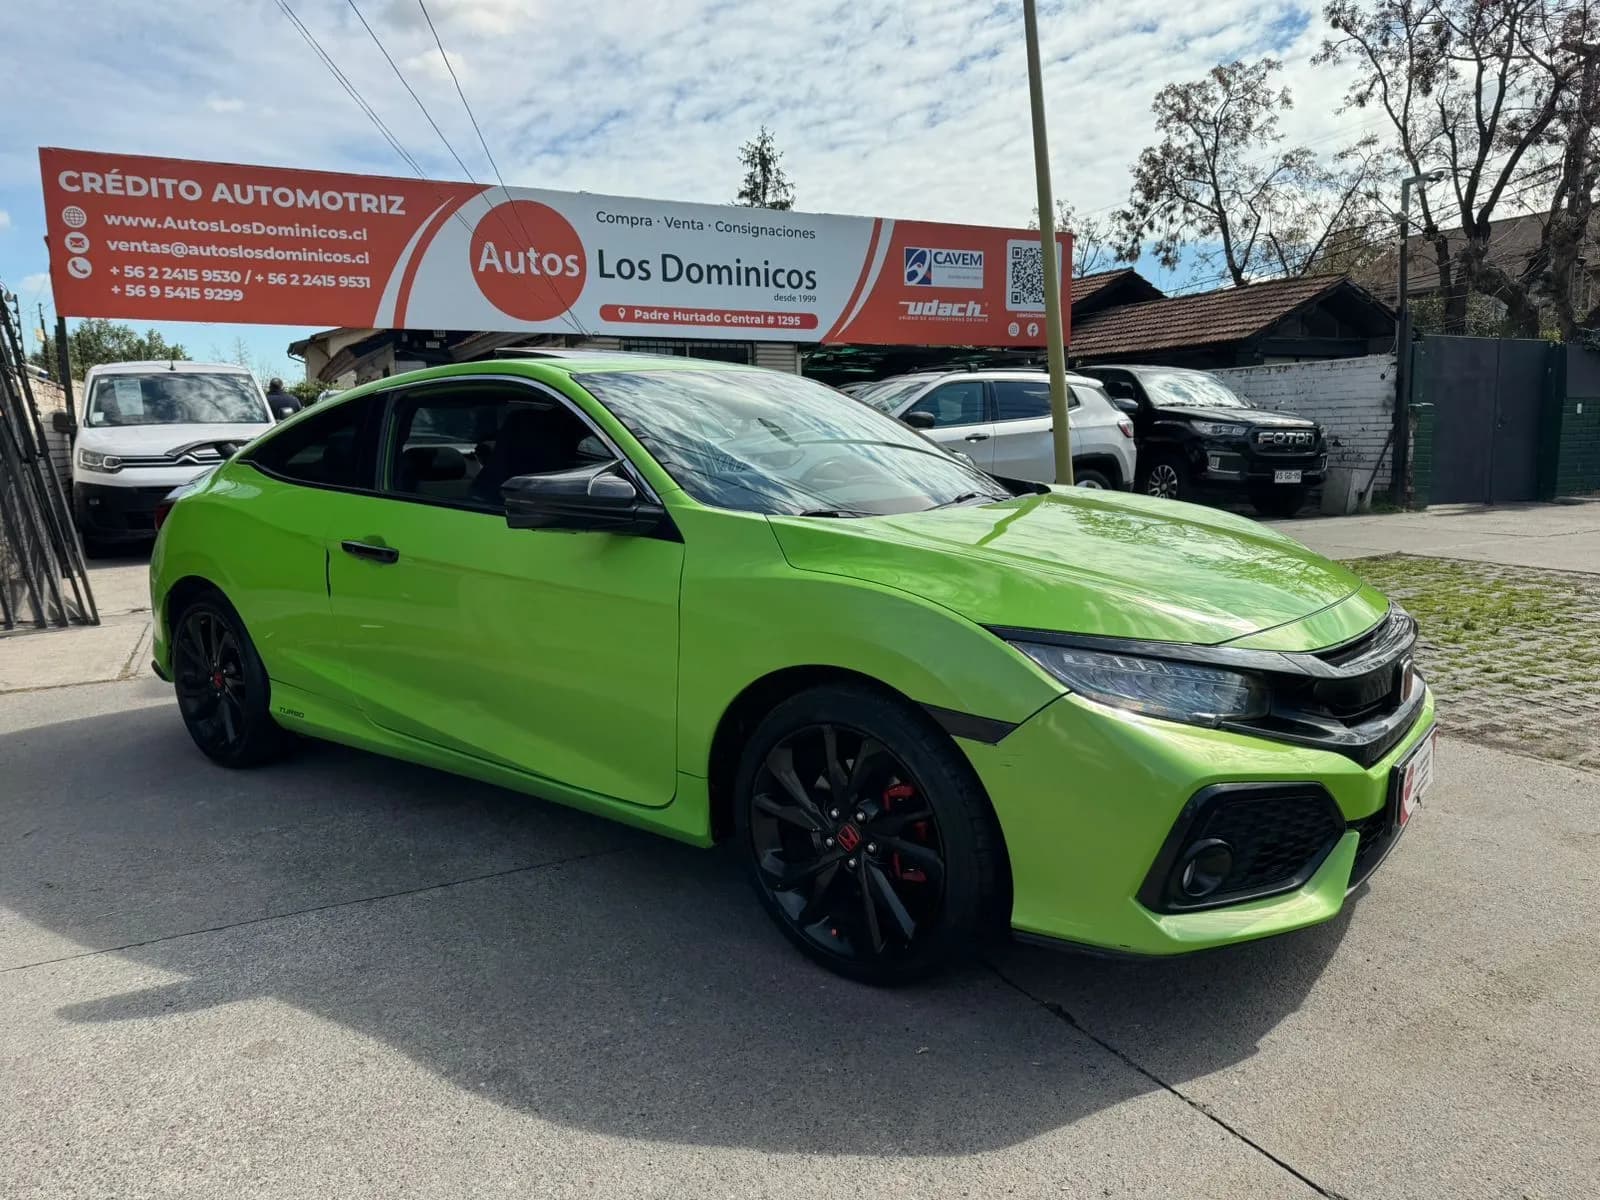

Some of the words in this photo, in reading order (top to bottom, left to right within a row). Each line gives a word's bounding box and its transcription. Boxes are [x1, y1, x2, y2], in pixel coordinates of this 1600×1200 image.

[58, 168, 203, 201] CRÉDITO
[211, 182, 406, 216] AUTOMOTRIZ
[103, 213, 368, 241] www.AutosLosDominicos.cl
[596, 210, 653, 228] Compra
[664, 215, 704, 231] Venta
[715, 220, 816, 240] Consignaciones
[106, 239, 370, 265] ventas@autoslosdominicos.cl
[478, 240, 580, 276] Autos
[933, 251, 983, 265] CAVEM
[123, 265, 146, 278] 56
[148, 266, 159, 279] 2
[162, 267, 199, 281] 2415
[202, 269, 242, 283] 9530
[267, 272, 288, 285] 56
[289, 274, 300, 286] 2
[302, 274, 336, 287] 2415
[338, 275, 371, 288] 9531
[598, 248, 652, 282] Los
[661, 253, 817, 290] Dominicos
[125, 284, 146, 297] 56
[149, 285, 161, 298] 9
[164, 286, 201, 300] 5415
[203, 287, 244, 302] 9299
[773, 292, 797, 303] desde
[798, 294, 817, 303] 1999
[634, 308, 670, 321] Padre
[673, 311, 721, 323] Hurtado
[724, 313, 764, 325] Central
[767, 316, 775, 325] #
[777, 315, 801, 326] 1295
[1258, 431, 1315, 444] FOTON
